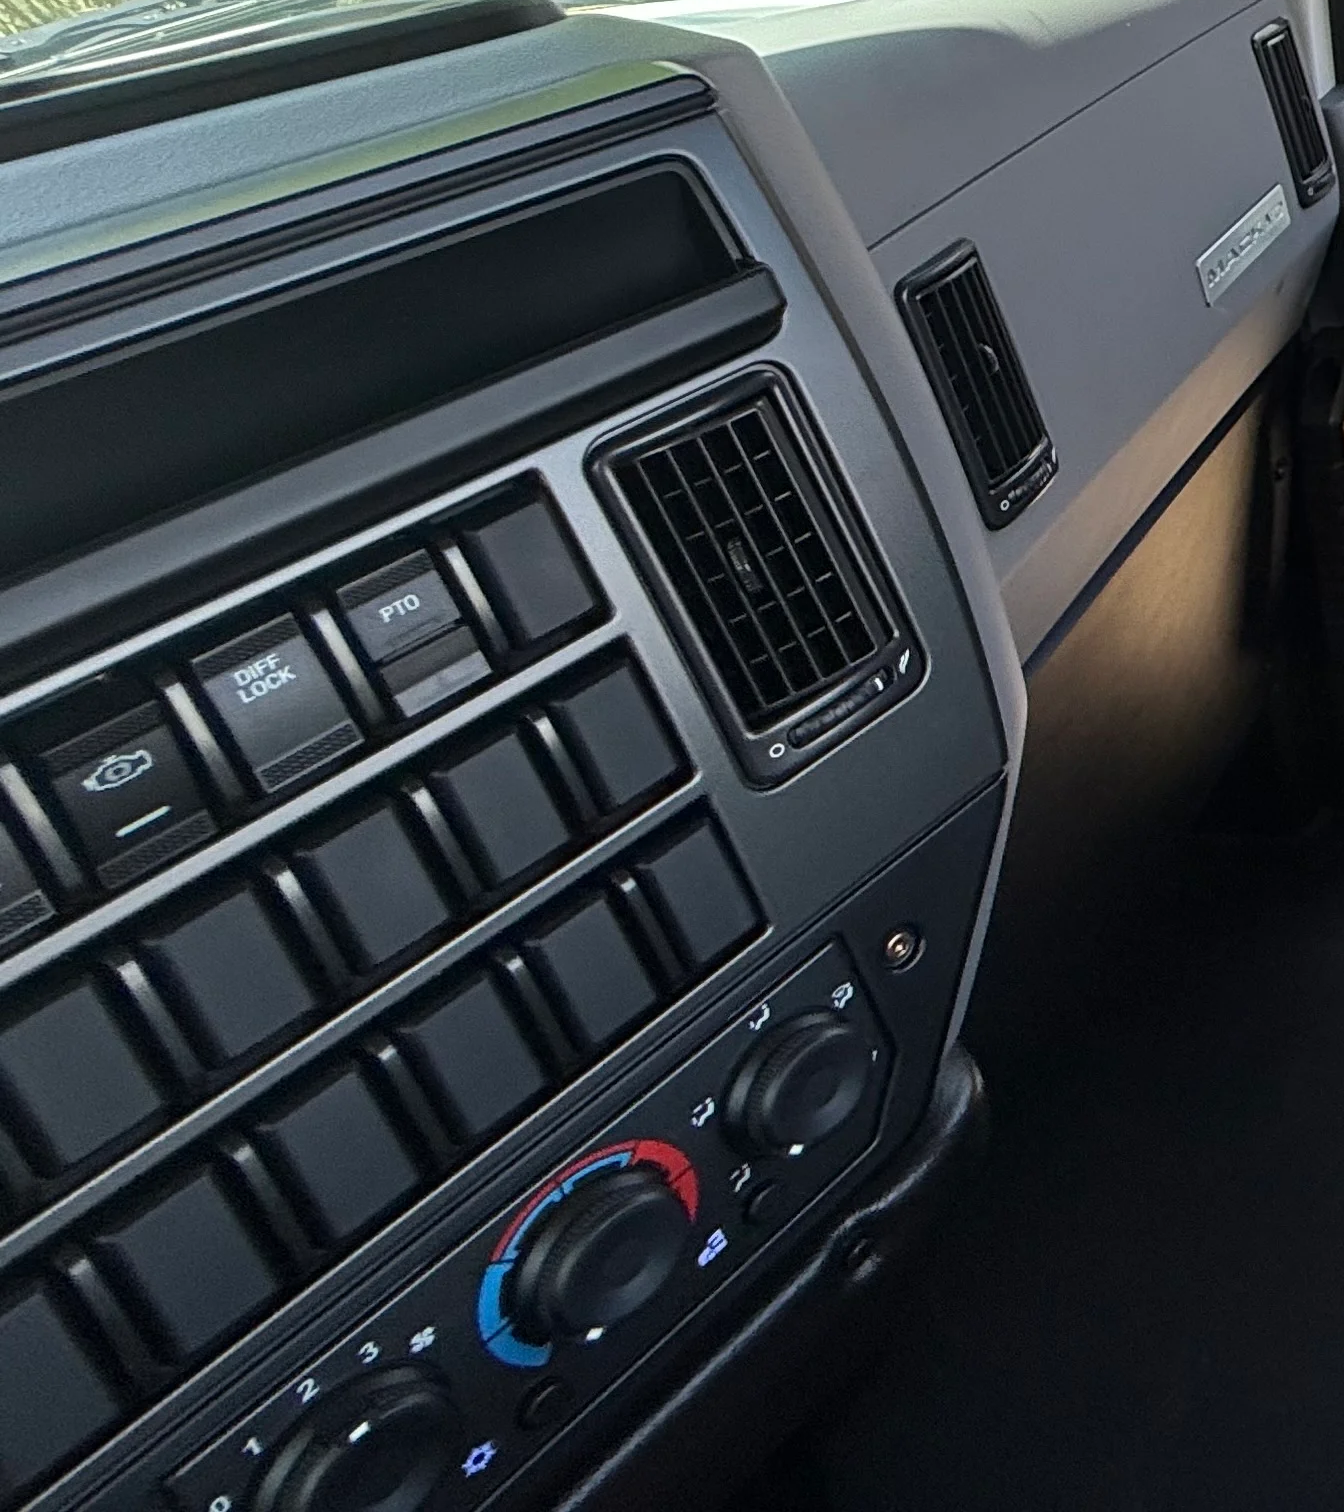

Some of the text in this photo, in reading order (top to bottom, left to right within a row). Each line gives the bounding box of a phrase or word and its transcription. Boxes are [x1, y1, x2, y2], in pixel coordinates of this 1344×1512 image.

[377, 593, 421, 624] PTO
[232, 652, 281, 687] DIFF
[235, 664, 297, 704] LOCK
[358, 1340, 380, 1365] 3
[296, 1377, 320, 1404] 2
[242, 1437, 264, 1456] 1
